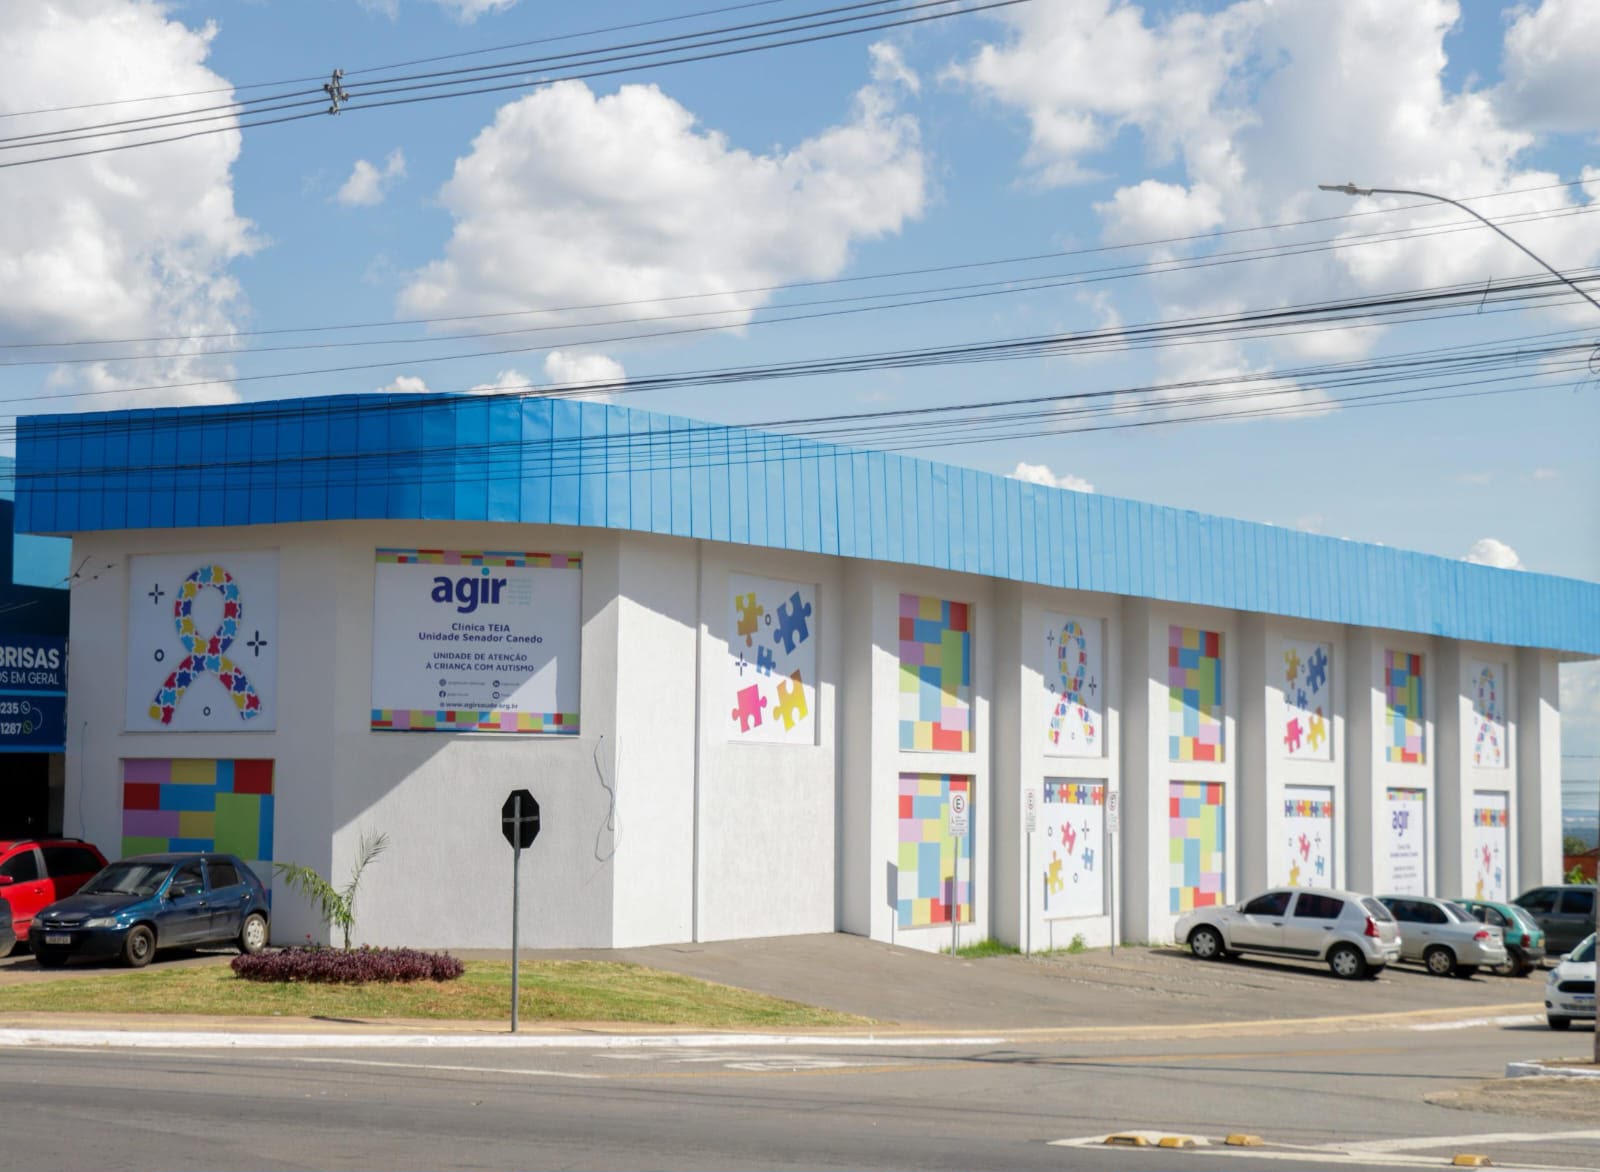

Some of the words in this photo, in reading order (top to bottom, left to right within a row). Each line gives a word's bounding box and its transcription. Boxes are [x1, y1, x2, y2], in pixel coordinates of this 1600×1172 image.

[431, 567, 507, 614] agir
[488, 623, 511, 633] TEIA
[418, 631, 460, 641] Unidade
[462, 632, 503, 643] Senador
[506, 634, 543, 644] Canedo
[433, 652, 471, 660] UNIDADE
[474, 653, 485, 661] DE
[488, 653, 528, 662] ATENÇÃO
[434, 662, 472, 671] CRIANÇA
[474, 663, 494, 671] COM
[496, 664, 534, 673] AUTISMO
[11, 671, 26, 684] EM
[28, 671, 60, 685] GERAL
[0, 702, 19, 715] 235
[1, 722, 22, 735] 1287
